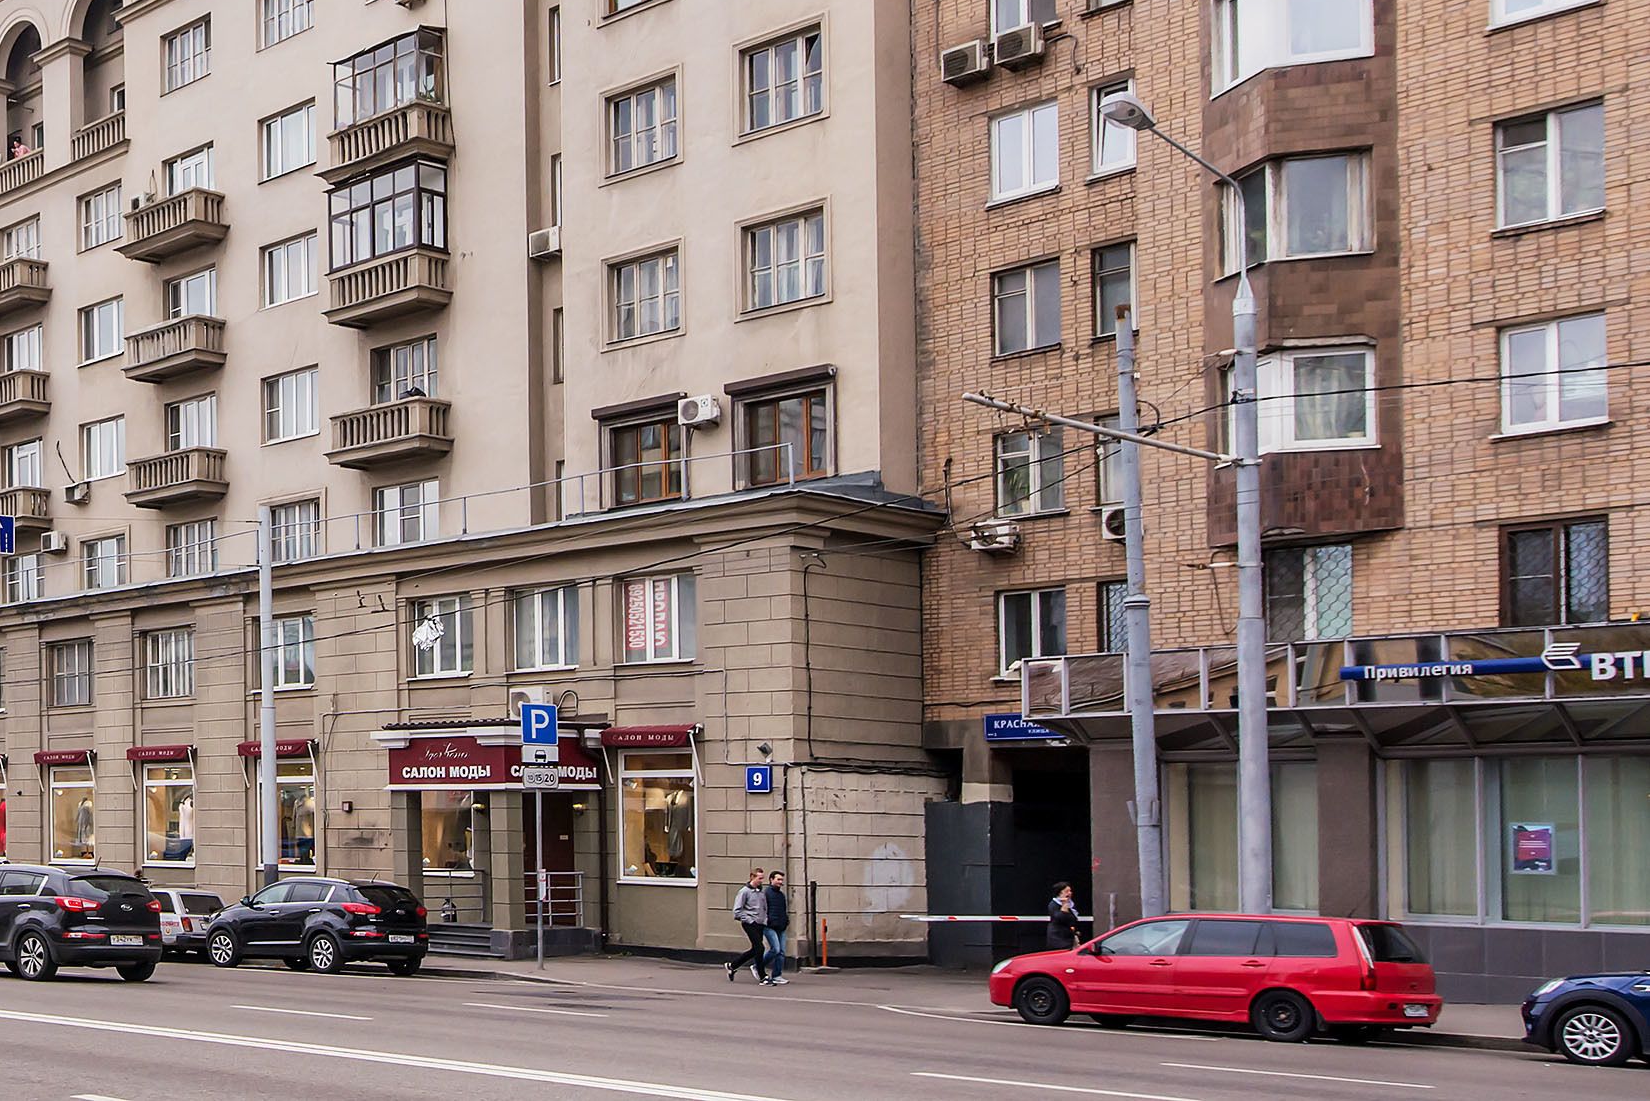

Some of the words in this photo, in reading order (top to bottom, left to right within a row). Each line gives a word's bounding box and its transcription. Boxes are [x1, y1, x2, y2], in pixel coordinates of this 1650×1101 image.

[628, 583, 646, 648] 89250521530
[1363, 663, 1473, 681] Привилегия
[530, 709, 550, 739] P
[994, 720, 1040, 729] КРАСНА
[402, 766, 446, 779] САЛОН
[449, 765, 491, 780] МОДЫ
[544, 773, 555, 783] 20
[558, 766, 597, 780] МОДЫ
[752, 772, 763, 786] 9
